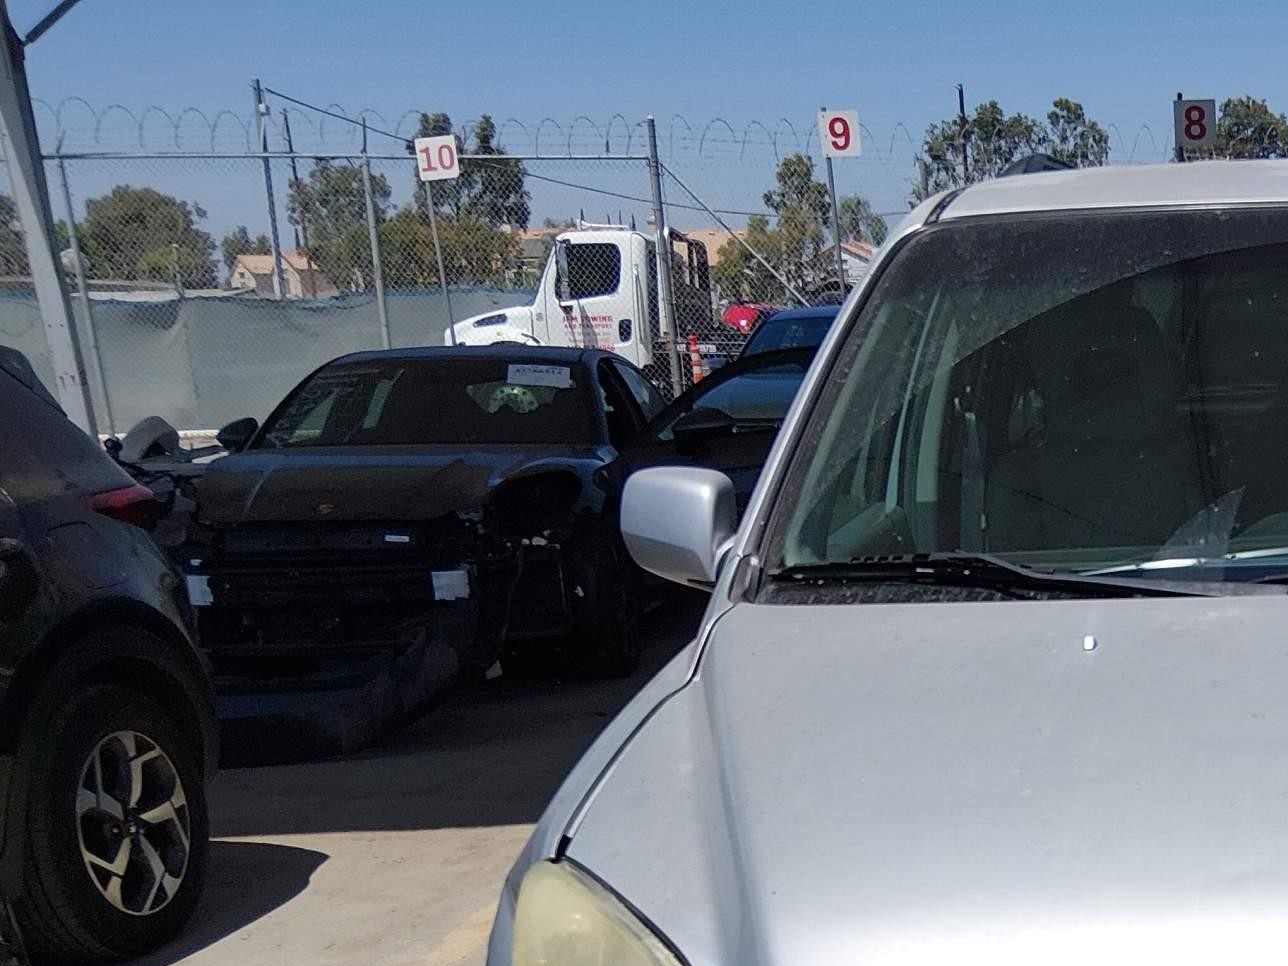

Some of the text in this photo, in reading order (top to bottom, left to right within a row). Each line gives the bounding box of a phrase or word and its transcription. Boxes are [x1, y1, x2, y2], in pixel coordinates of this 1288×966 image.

[829, 117, 850, 151] 9
[1184, 105, 1206, 140] 8
[419, 144, 455, 172] 10
